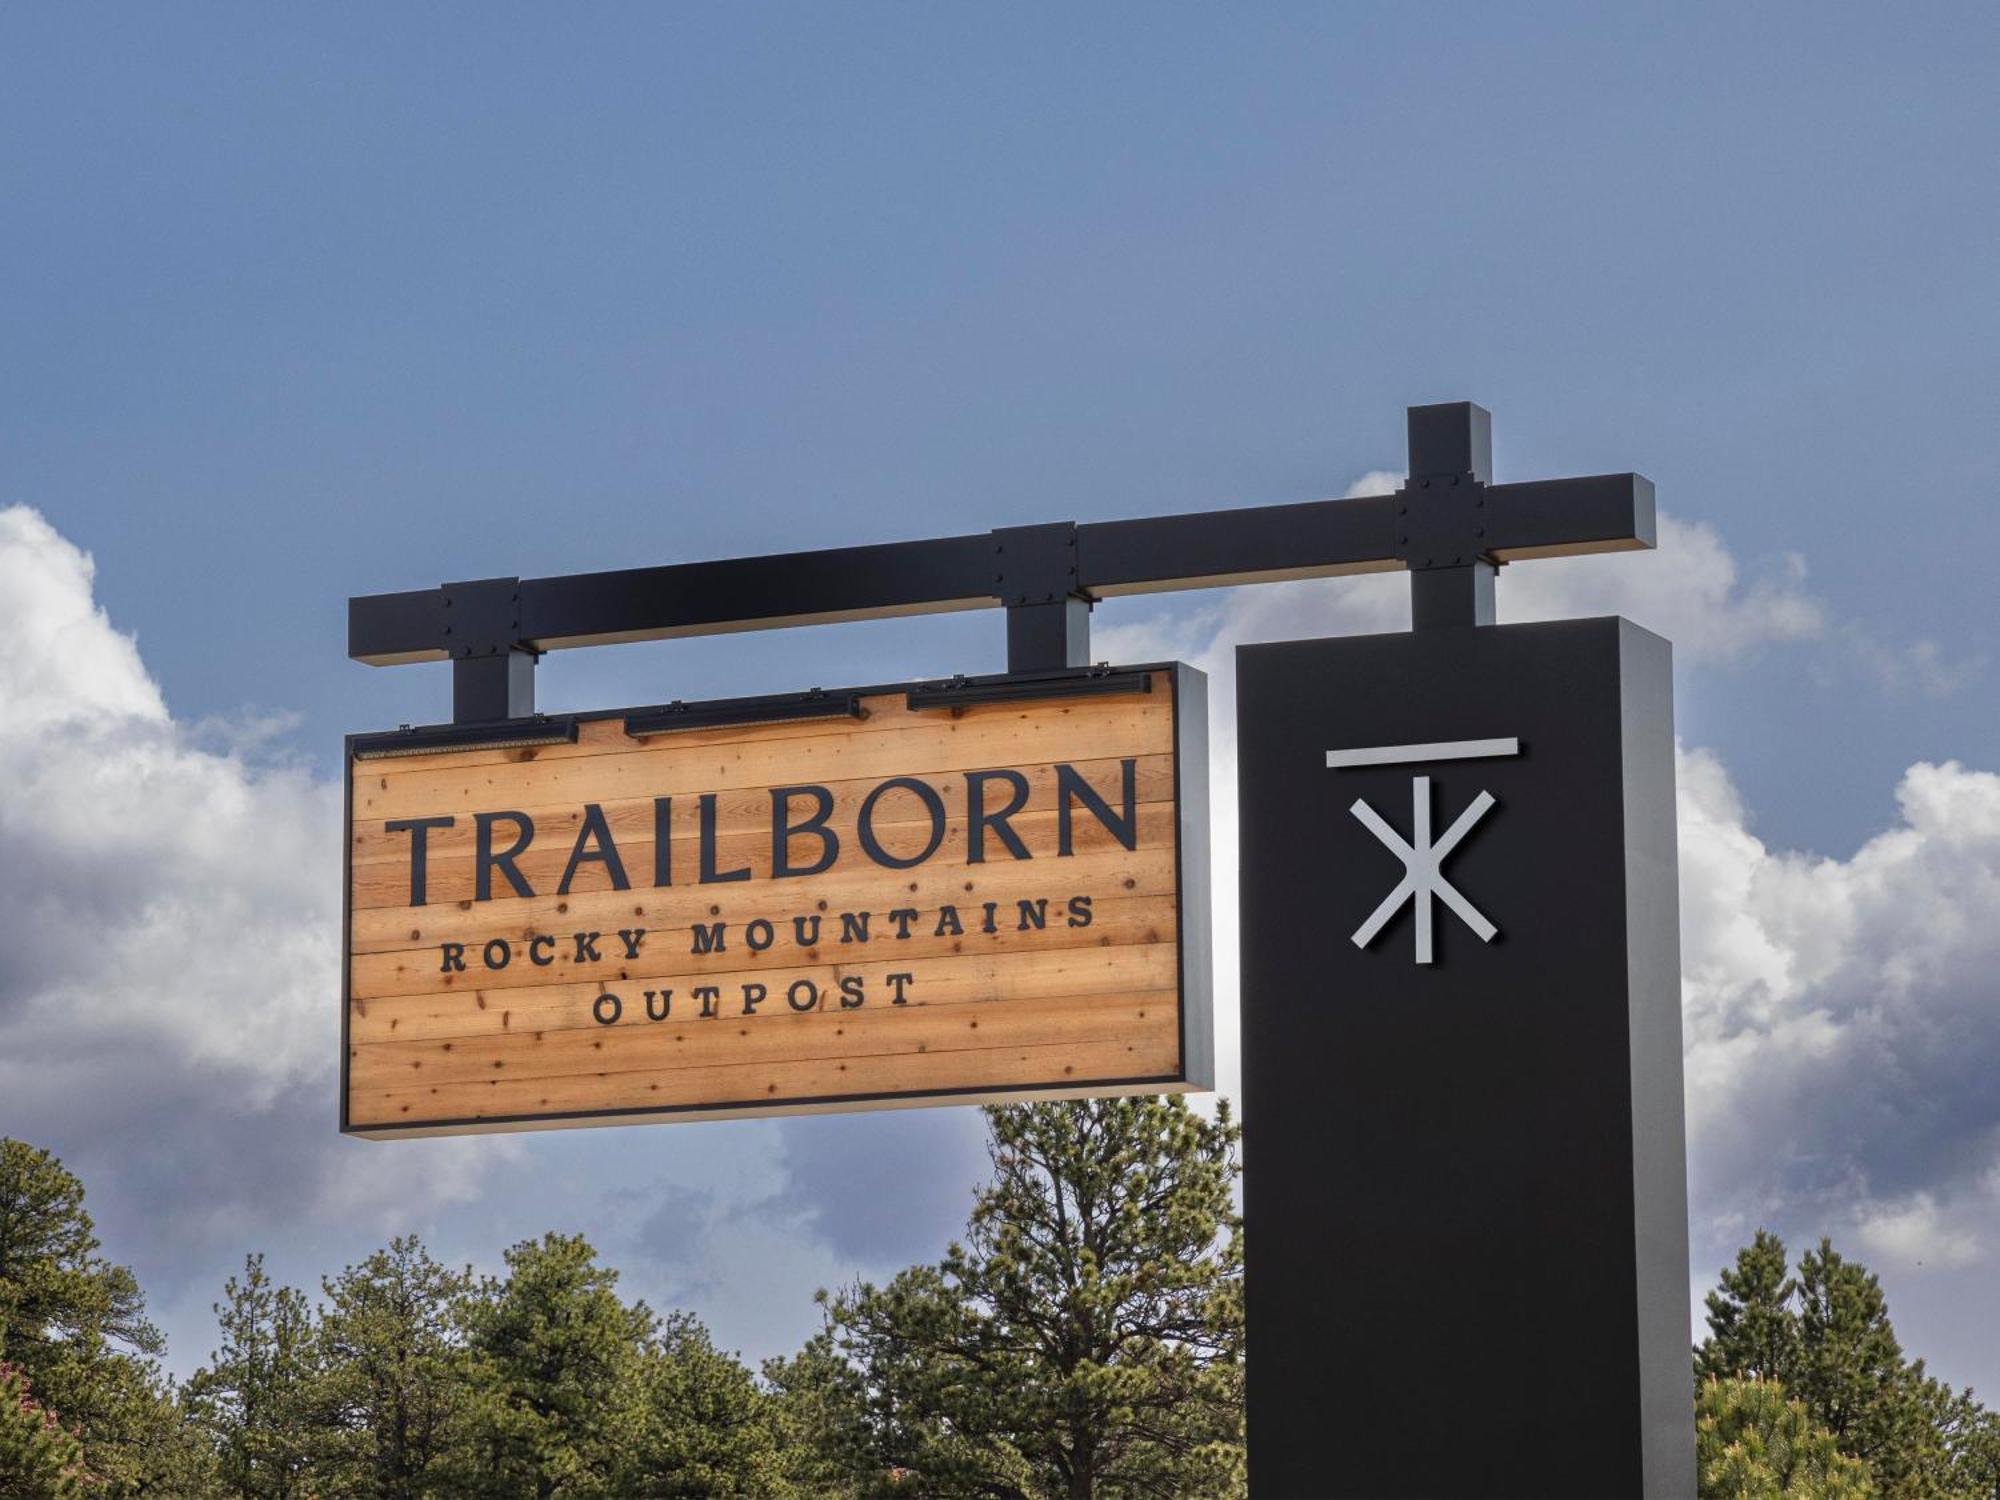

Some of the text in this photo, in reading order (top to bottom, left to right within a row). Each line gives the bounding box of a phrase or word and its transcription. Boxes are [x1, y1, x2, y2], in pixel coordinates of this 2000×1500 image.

[385, 758, 1137, 907] TRAILBORN
[440, 896, 1094, 974] ROCKY MOUNTAINS
[594, 974, 917, 1025] OUTPOST
